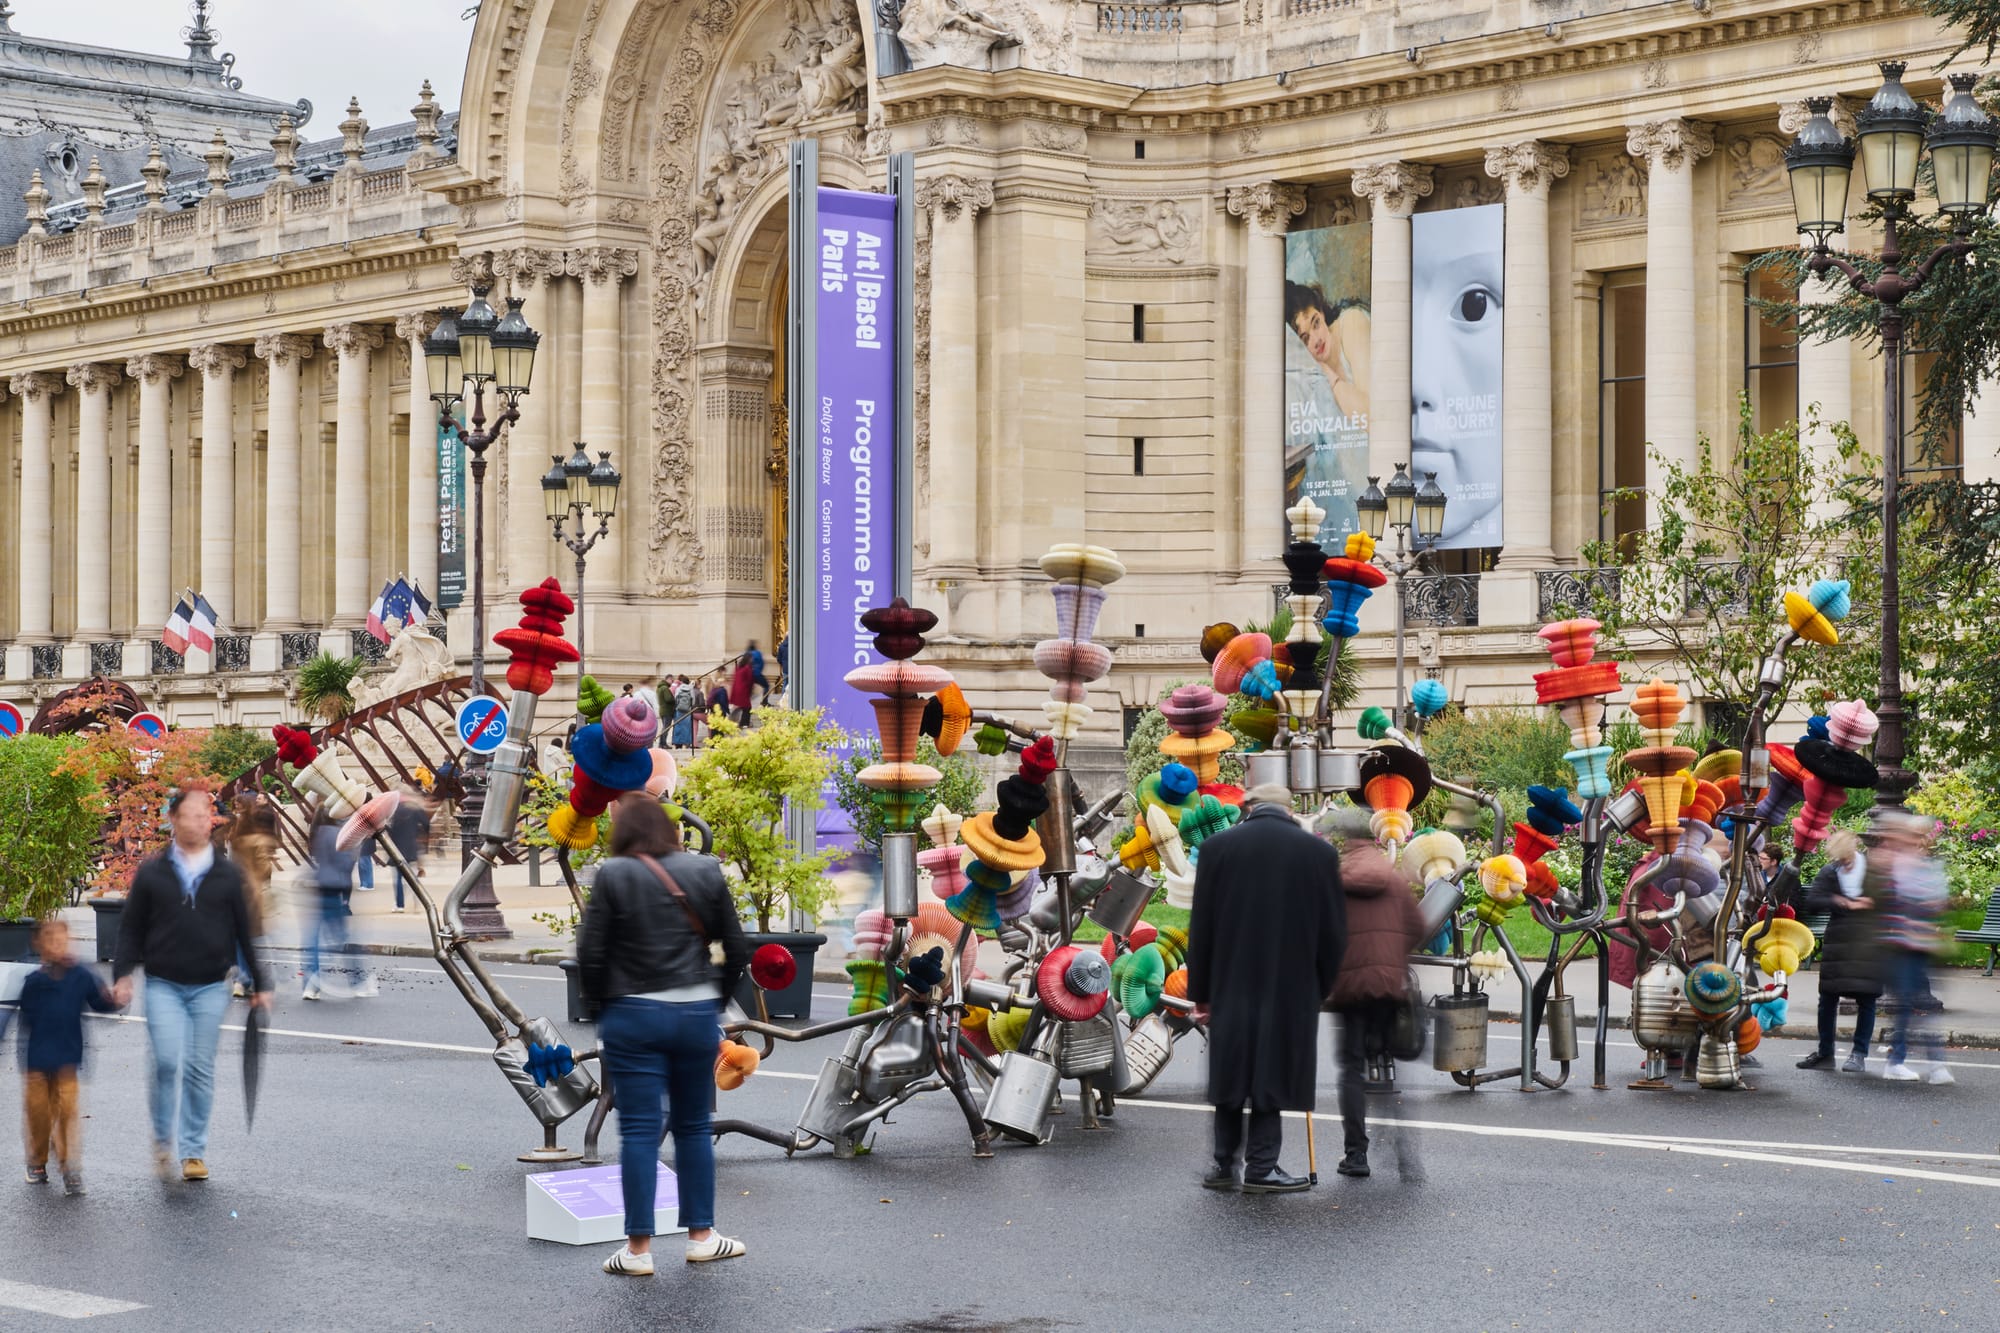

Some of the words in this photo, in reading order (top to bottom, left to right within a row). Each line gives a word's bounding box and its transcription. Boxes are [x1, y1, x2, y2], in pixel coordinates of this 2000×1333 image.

[822, 228, 848, 293] Paris
[821, 396, 833, 434] Dollys
[1290, 400, 1318, 418] EVA
[1290, 409, 1368, 436] GONZALÈS
[1447, 394, 1497, 413] PRUNE
[441, 438, 451, 499] Palais
[822, 448, 833, 486] Beaux
[850, 399, 875, 573] Programme
[441, 504, 451, 554] Petit
[822, 499, 833, 545] Cosima
[822, 547, 831, 571] von
[822, 574, 833, 612] Bonin
